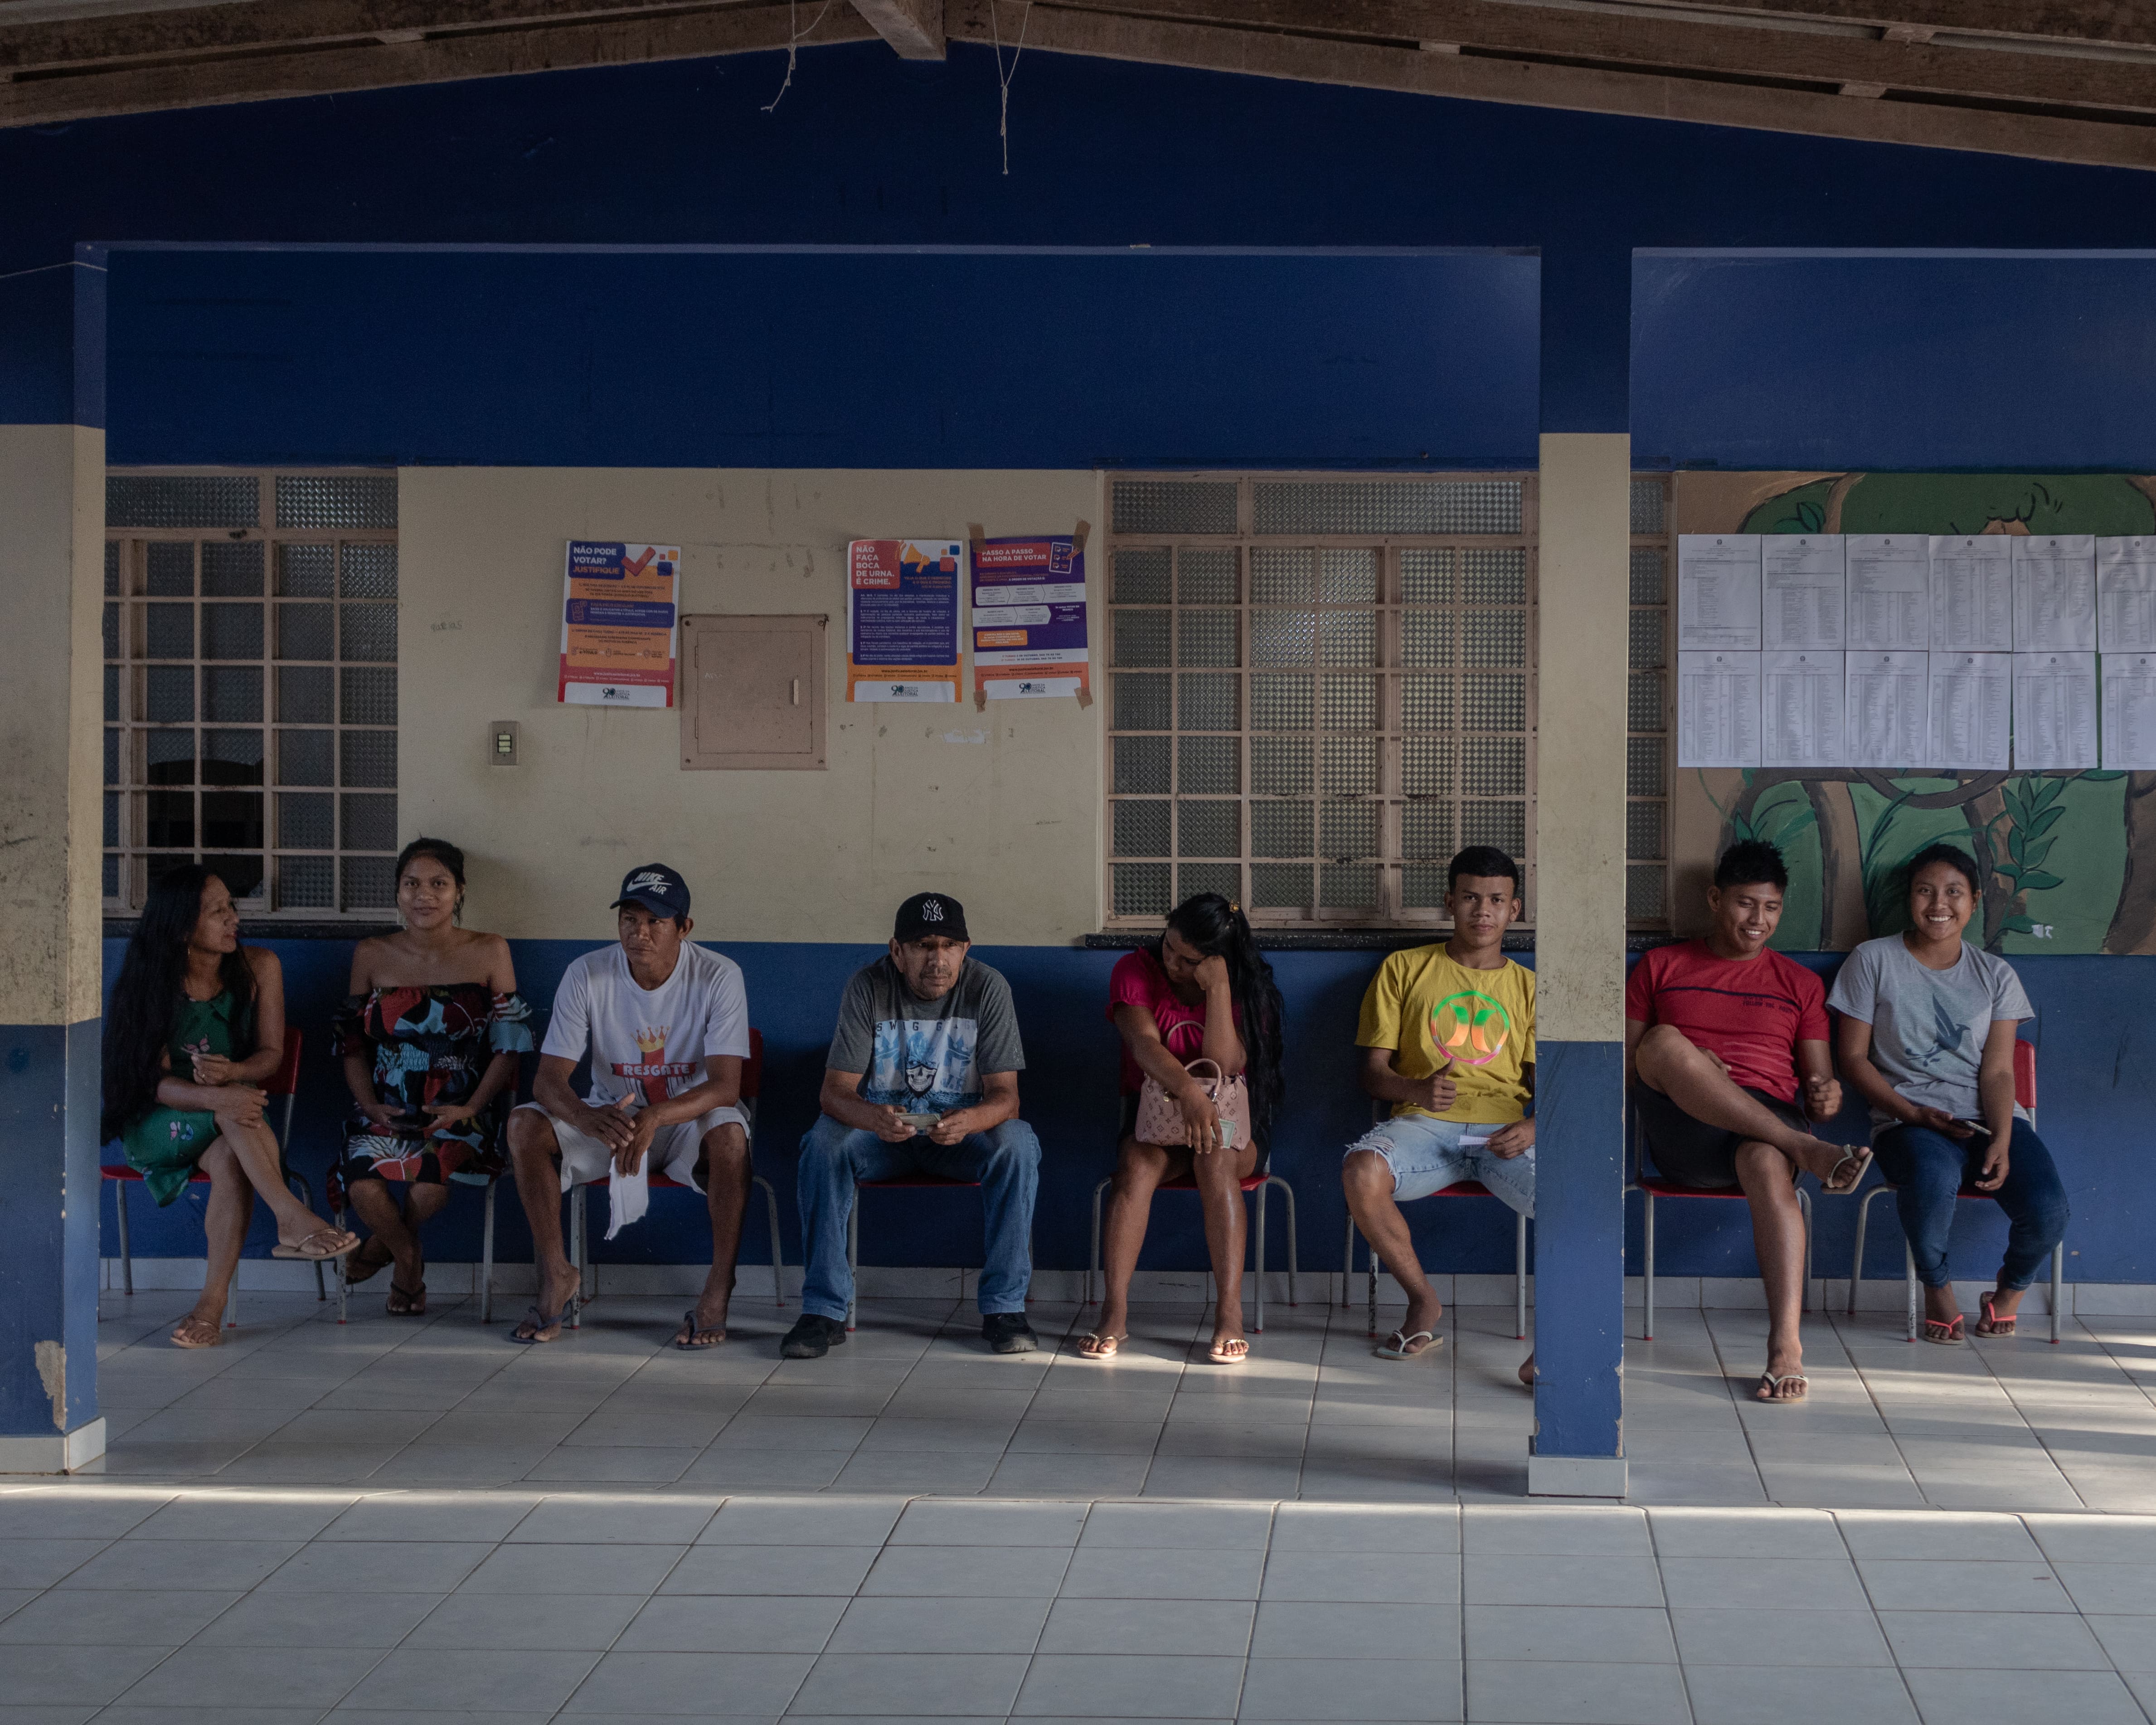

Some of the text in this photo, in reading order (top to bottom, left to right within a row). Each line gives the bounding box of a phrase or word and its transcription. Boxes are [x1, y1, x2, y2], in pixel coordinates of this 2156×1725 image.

[573, 545, 617, 555] NÃO PODE
[573, 556, 607, 564] VOTAR?
[573, 566, 620, 574] JUSTIFIQUE
[634, 872, 665, 882] NIKE
[648, 884, 667, 895] AIR
[623, 1064, 690, 1077] RESGATE
